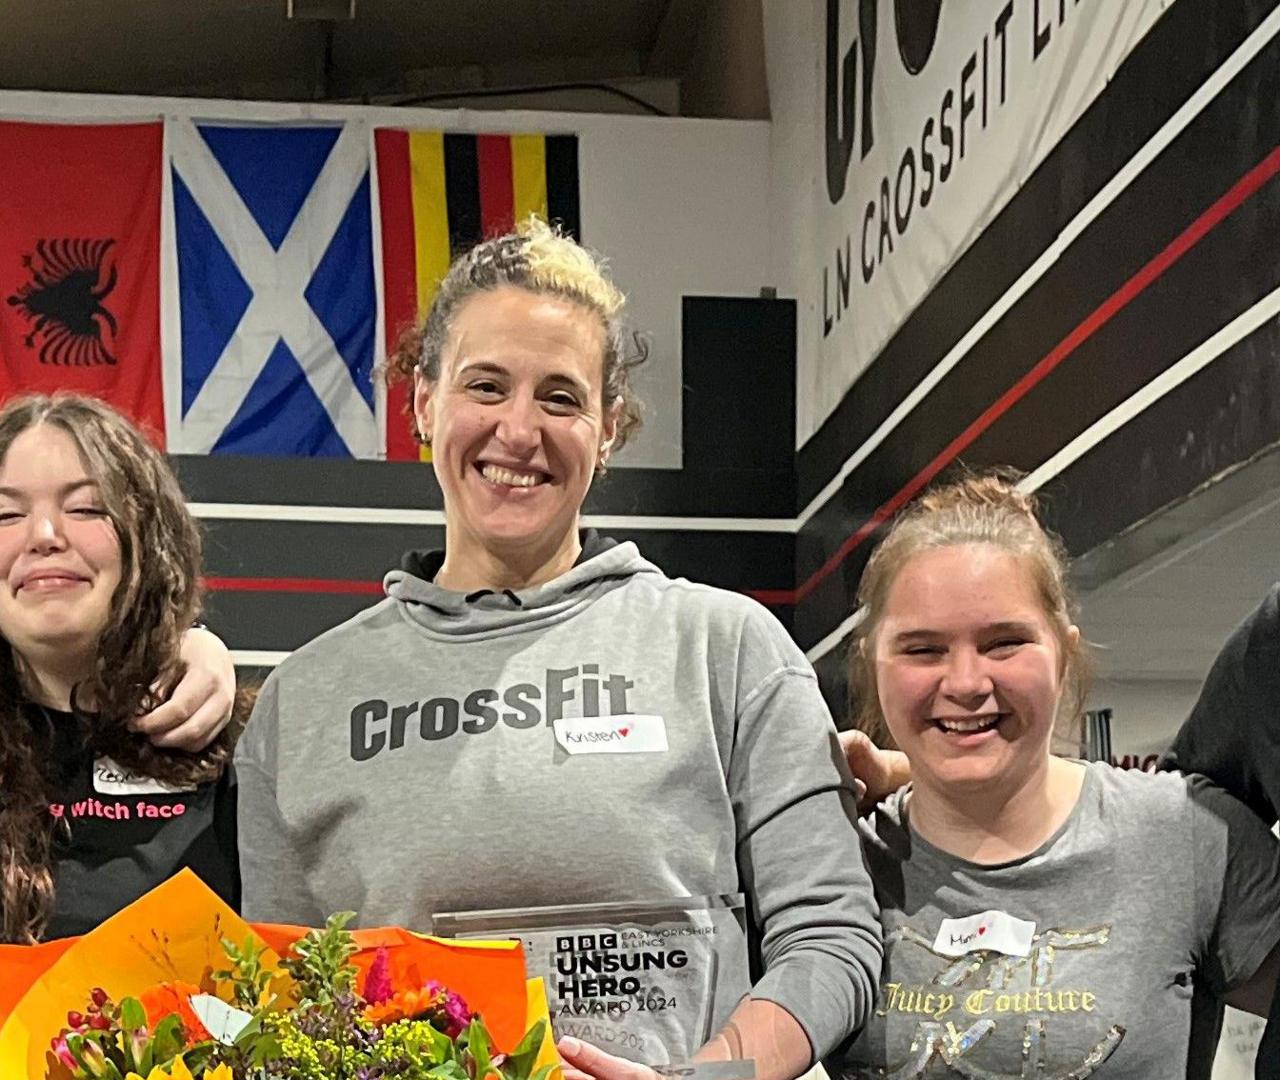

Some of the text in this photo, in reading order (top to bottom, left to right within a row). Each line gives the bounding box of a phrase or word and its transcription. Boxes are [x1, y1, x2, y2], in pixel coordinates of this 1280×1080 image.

[861, 0, 1014, 284] CROSSFIT
[349, 663, 634, 767] CrossFit
[564, 728, 622, 744] Kristen
[70, 797, 131, 820] witch
[136, 801, 187, 818] face
[557, 933, 617, 951] BBC
[557, 950, 689, 976] UNSUNG
[558, 976, 641, 999] HERO
[559, 997, 677, 1016] AWARD 2024
[876, 982, 1096, 1021] Juicy Couture
